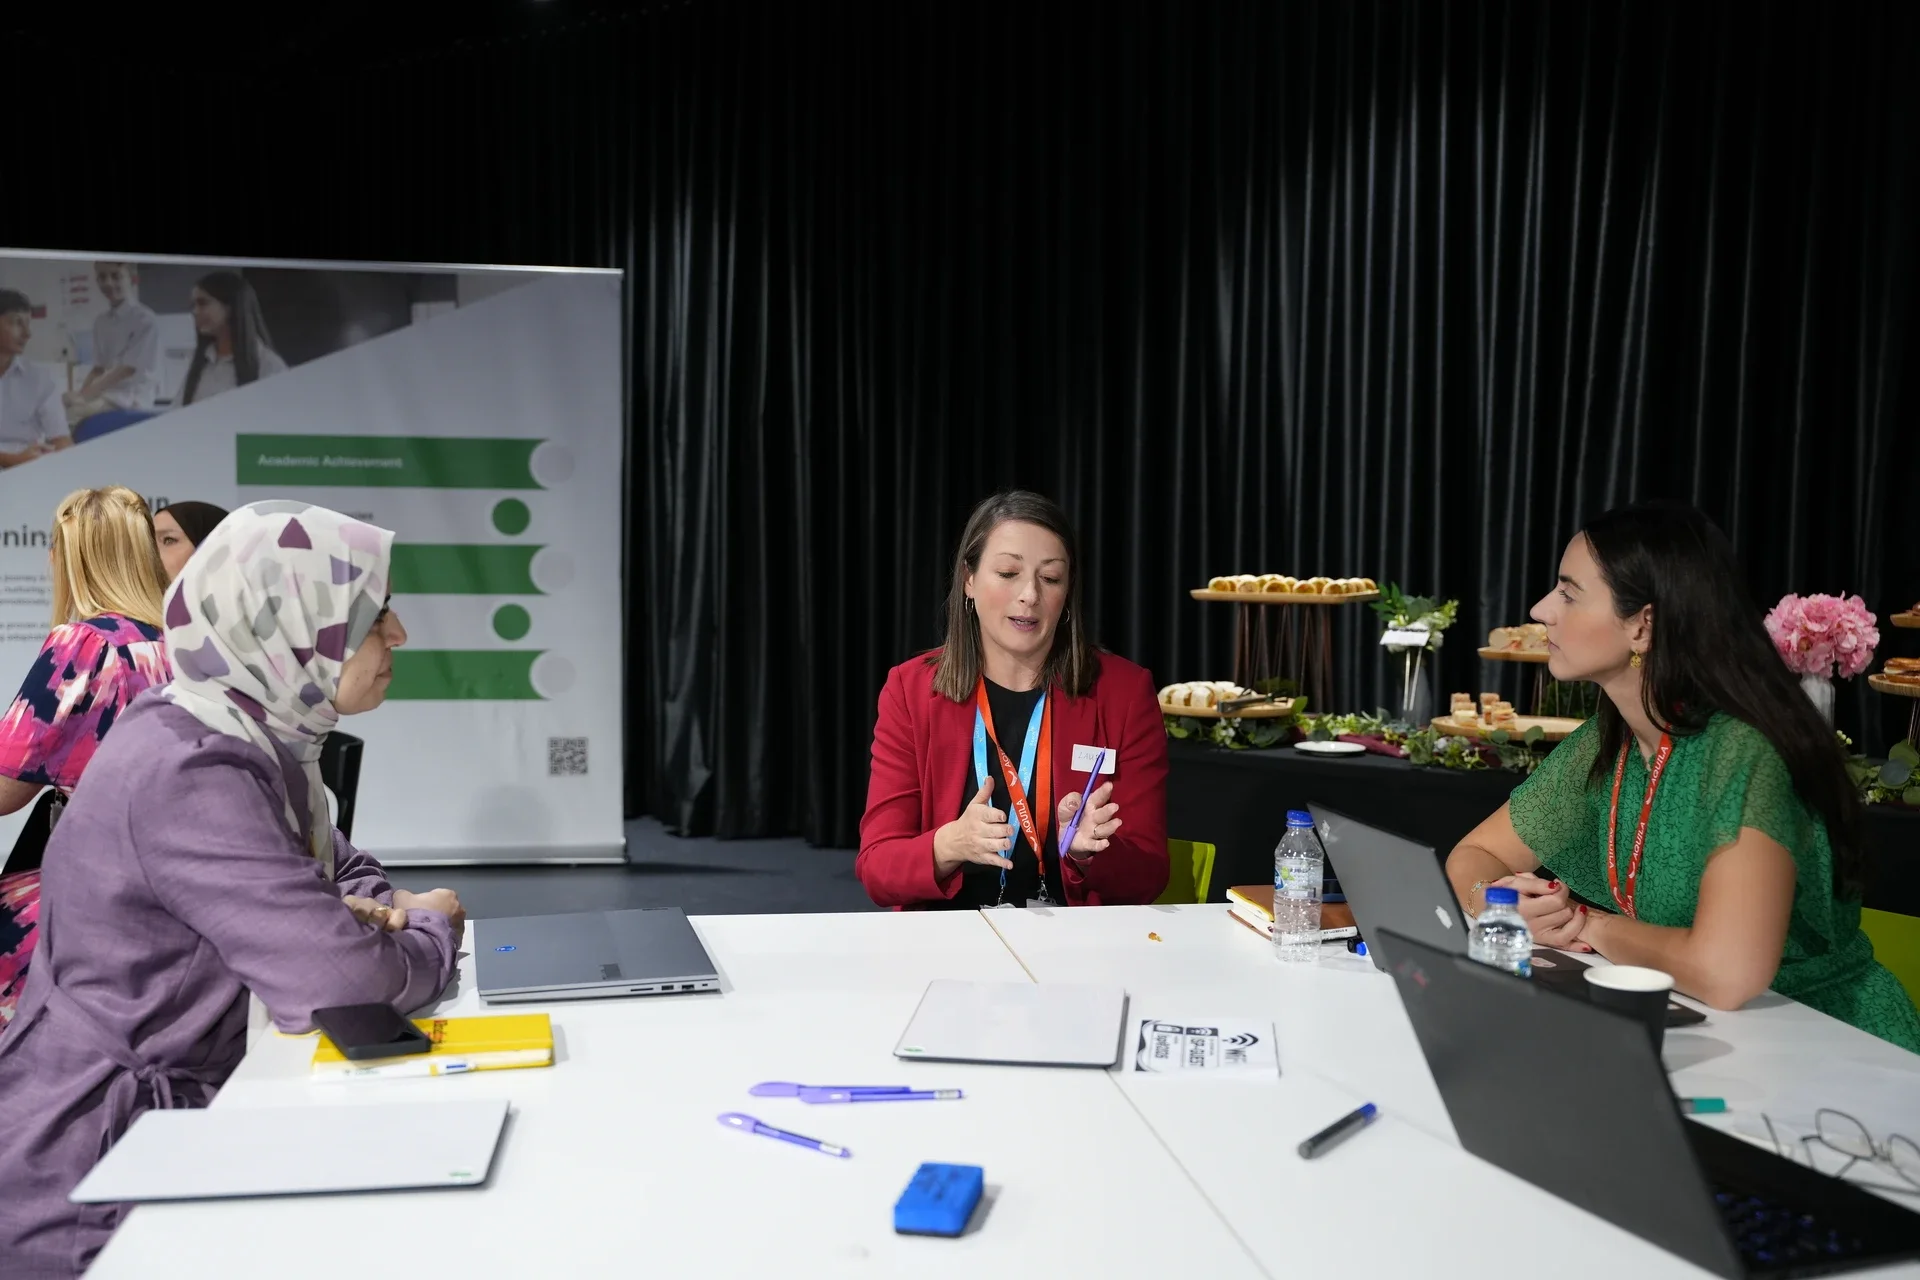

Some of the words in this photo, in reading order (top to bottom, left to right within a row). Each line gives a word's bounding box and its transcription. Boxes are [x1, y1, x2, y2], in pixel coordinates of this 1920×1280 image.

[258, 454, 319, 467] Academic
[322, 455, 403, 469] Achievement
[0, 524, 54, 548] nin
[1651, 746, 1669, 786] AQUILA
[1016, 798, 1033, 833] AQUILA
[1634, 822, 1646, 860] AQUILA
